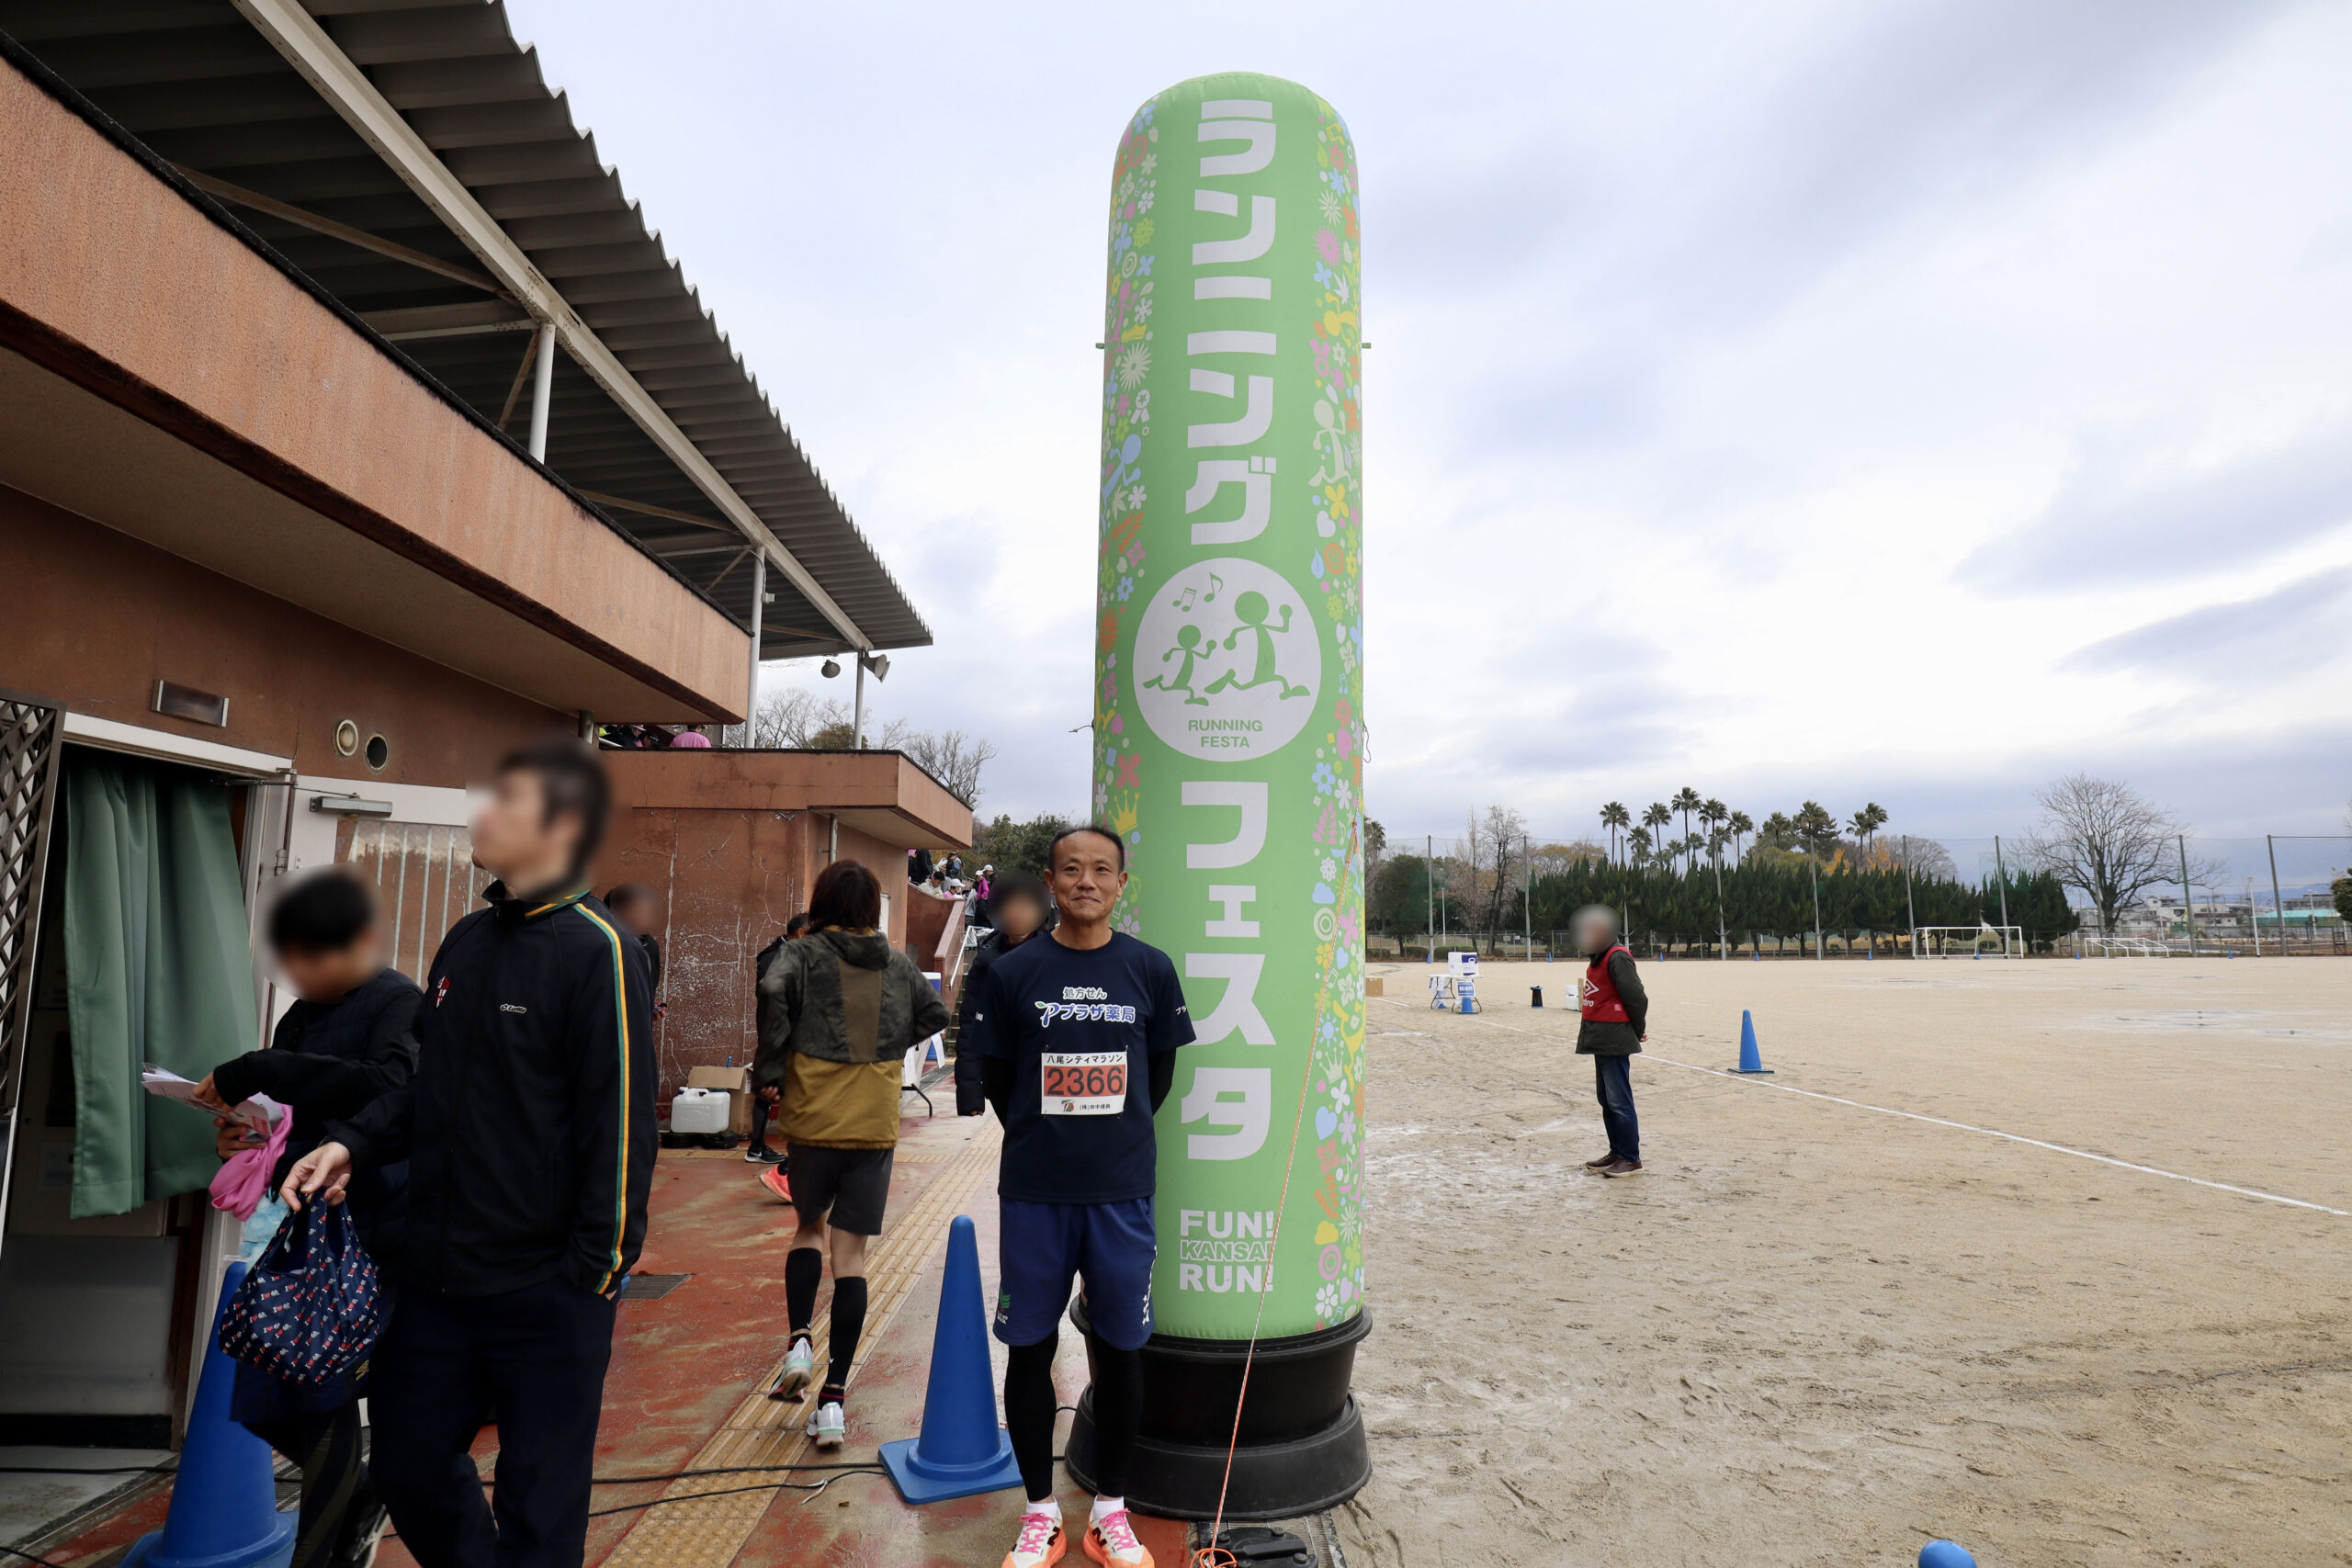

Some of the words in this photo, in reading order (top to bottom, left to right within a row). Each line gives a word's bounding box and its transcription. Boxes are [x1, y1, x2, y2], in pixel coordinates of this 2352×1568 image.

[1185, 99, 1277, 546] ランニング
[1188, 719, 1263, 732] RUNNING
[1200, 736, 1250, 748] FESTA
[1181, 781, 1277, 1161] フェスタ
[1063, 987, 1107, 999] 処方せん
[1047, 1055, 1123, 1065] 八尾シティマラソン
[1047, 1066, 1123, 1096] 2366
[1180, 1209, 1274, 1238] FUN!
[1180, 1239, 1273, 1262] KANSAI
[1179, 1263, 1274, 1293] RUN!
